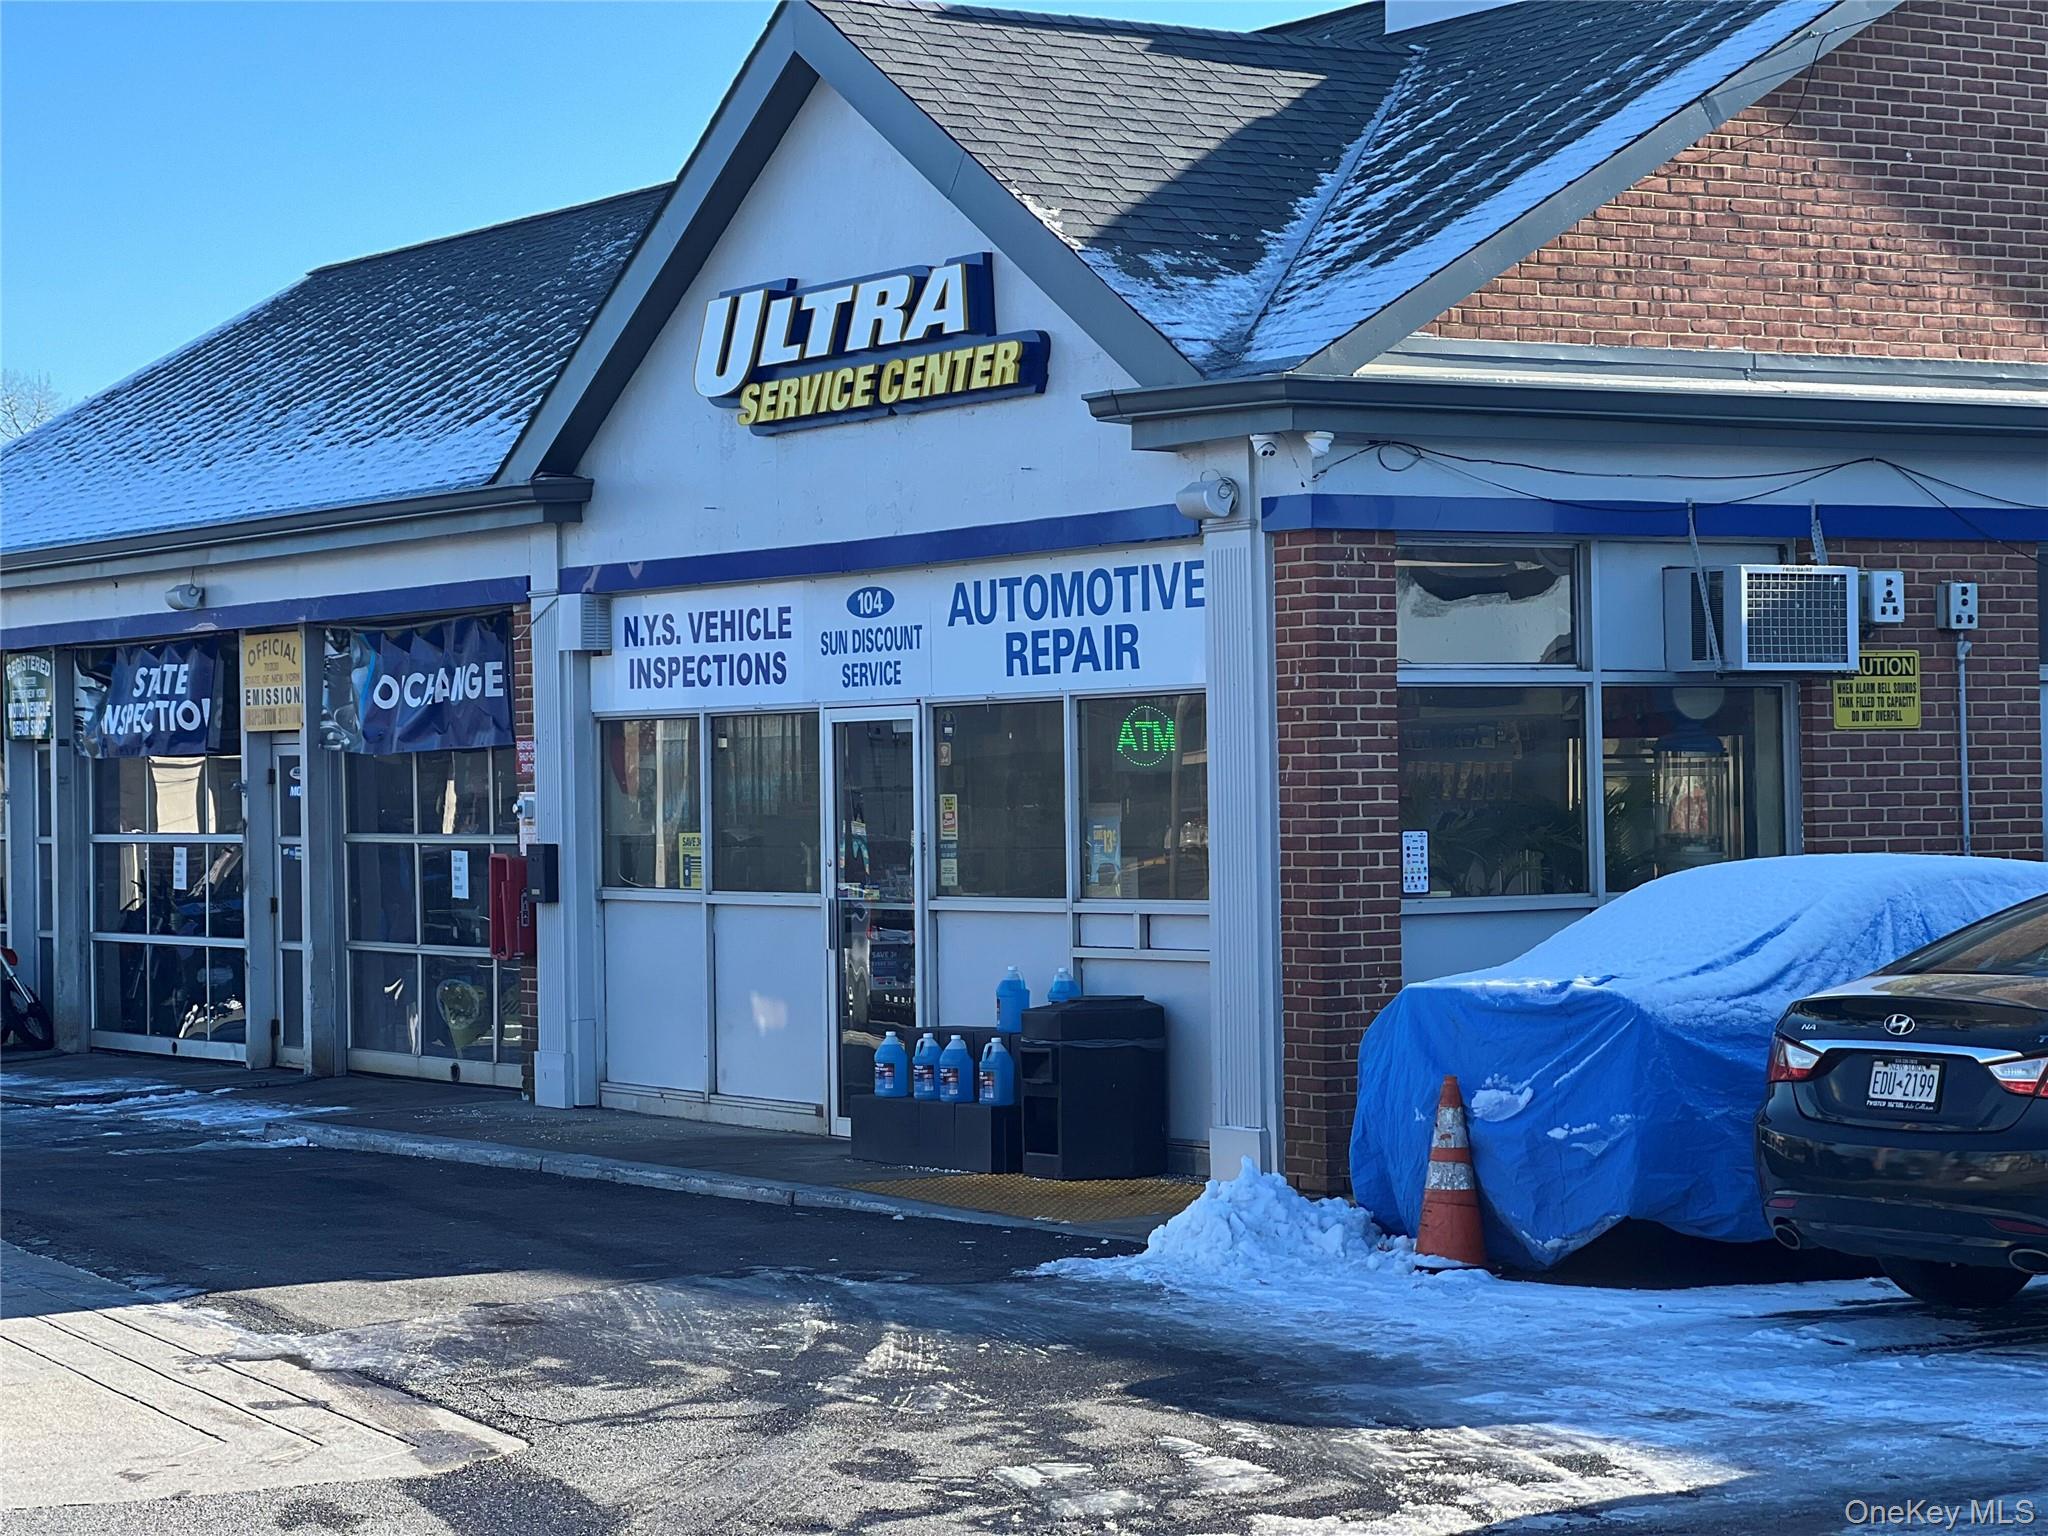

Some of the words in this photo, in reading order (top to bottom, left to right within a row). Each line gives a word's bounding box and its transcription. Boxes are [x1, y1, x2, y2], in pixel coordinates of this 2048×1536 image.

[694, 263, 969, 398] ULTRA
[737, 364, 879, 426] SERVICE
[878, 340, 1024, 404] CENTER
[857, 590, 884, 615] 104
[948, 559, 1205, 626] AUTOMOTIVE
[624, 613, 681, 647] N.Y.S.
[688, 606, 792, 643] VEHICLE
[820, 630, 848, 656] SUN
[852, 625, 922, 653] DISCOUNT
[247, 638, 296, 666] OFFICIAL
[1006, 623, 1140, 677] REPAIR
[6, 655, 51, 680] REGISTERED
[629, 651, 787, 689] INSPECTIONS
[842, 661, 901, 688] SERVICE
[1859, 657, 1914, 675] UTION
[245, 686, 303, 706] EMISSION
[1837, 683, 1853, 694] WHEN
[1856, 683, 1875, 694] ALARM
[1878, 682, 1891, 694] BELL
[1894, 682, 1916, 693] SOUNDS
[1838, 697, 1853, 708] TANK
[1856, 696, 1874, 707] FILLED
[1877, 696, 1884, 707] TO
[1887, 696, 1915, 707] CAPACITY
[1852, 710, 1859, 721] DO
[1862, 710, 1873, 721] NOT
[1876, 710, 1903, 721] OVERFILL
[1117, 720, 1176, 751] ATM
